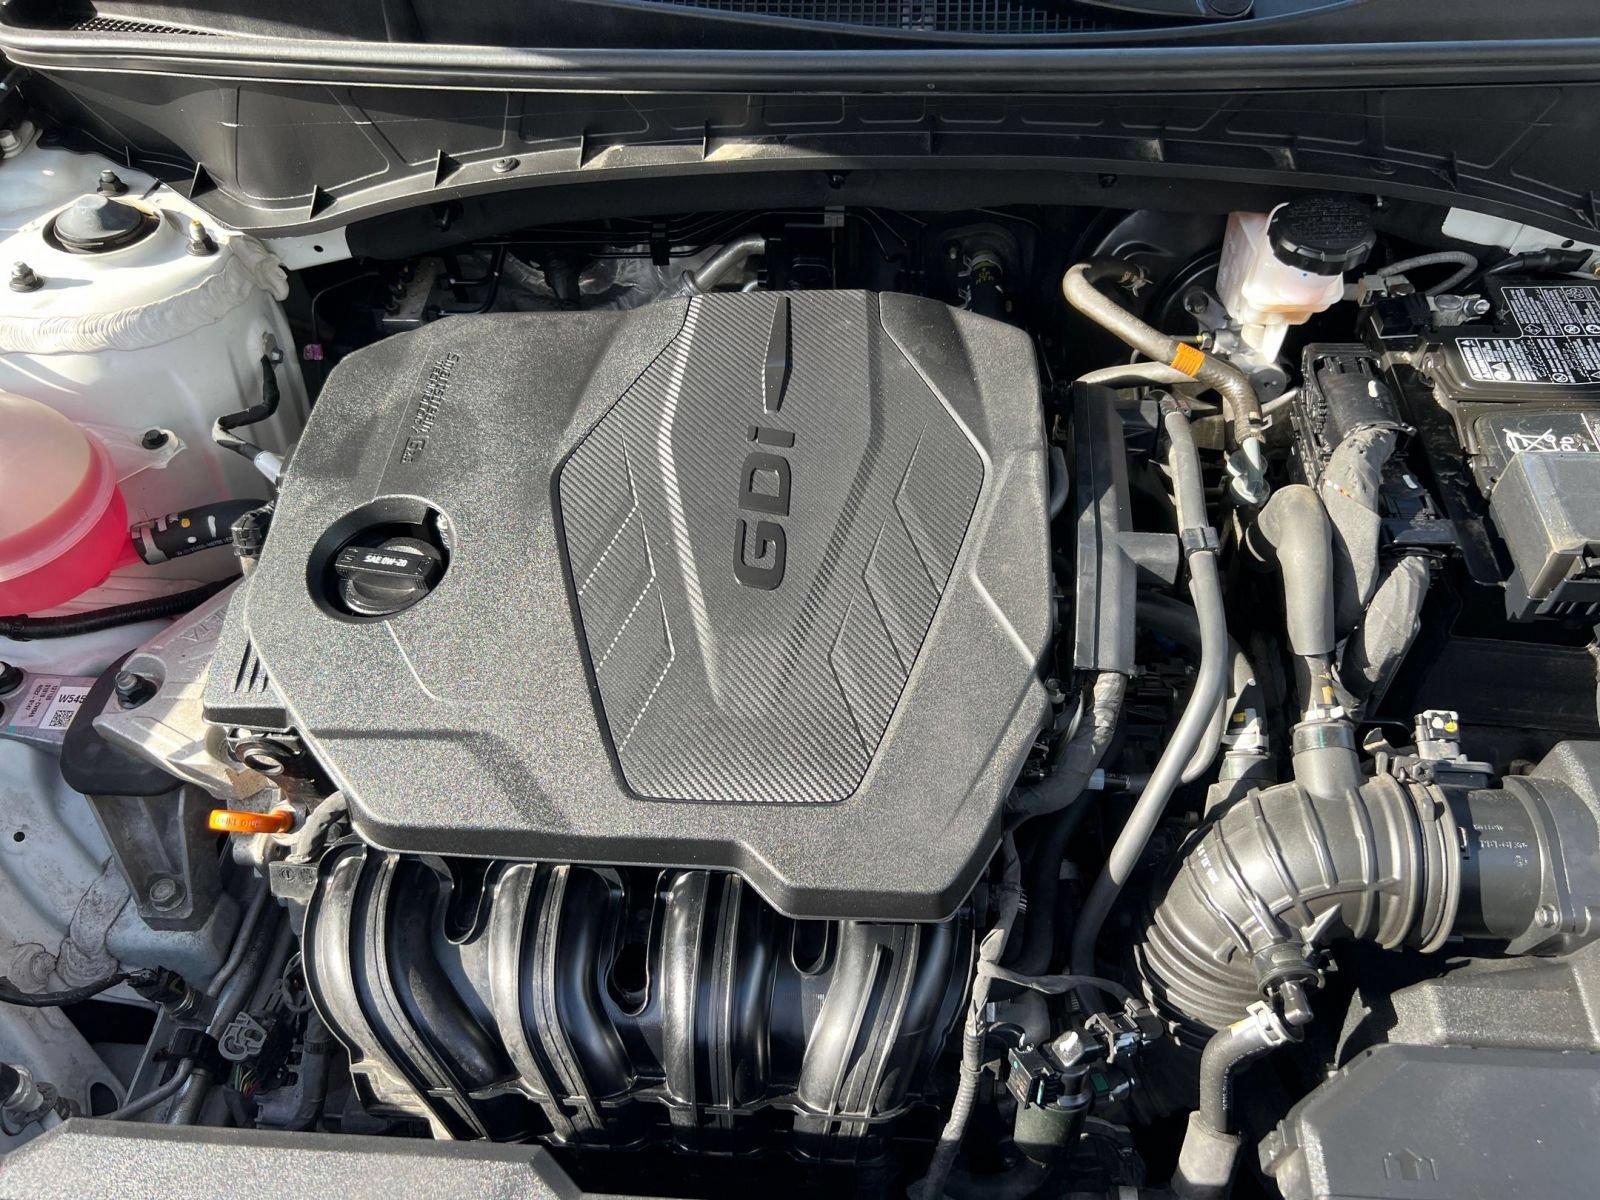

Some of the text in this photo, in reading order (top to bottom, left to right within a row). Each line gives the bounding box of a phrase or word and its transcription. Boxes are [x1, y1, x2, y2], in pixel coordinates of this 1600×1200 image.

[1560, 436, 1578, 452] Pb
[733, 424, 796, 591] GDi
[363, 554, 408, 568] SAE 0W-20
